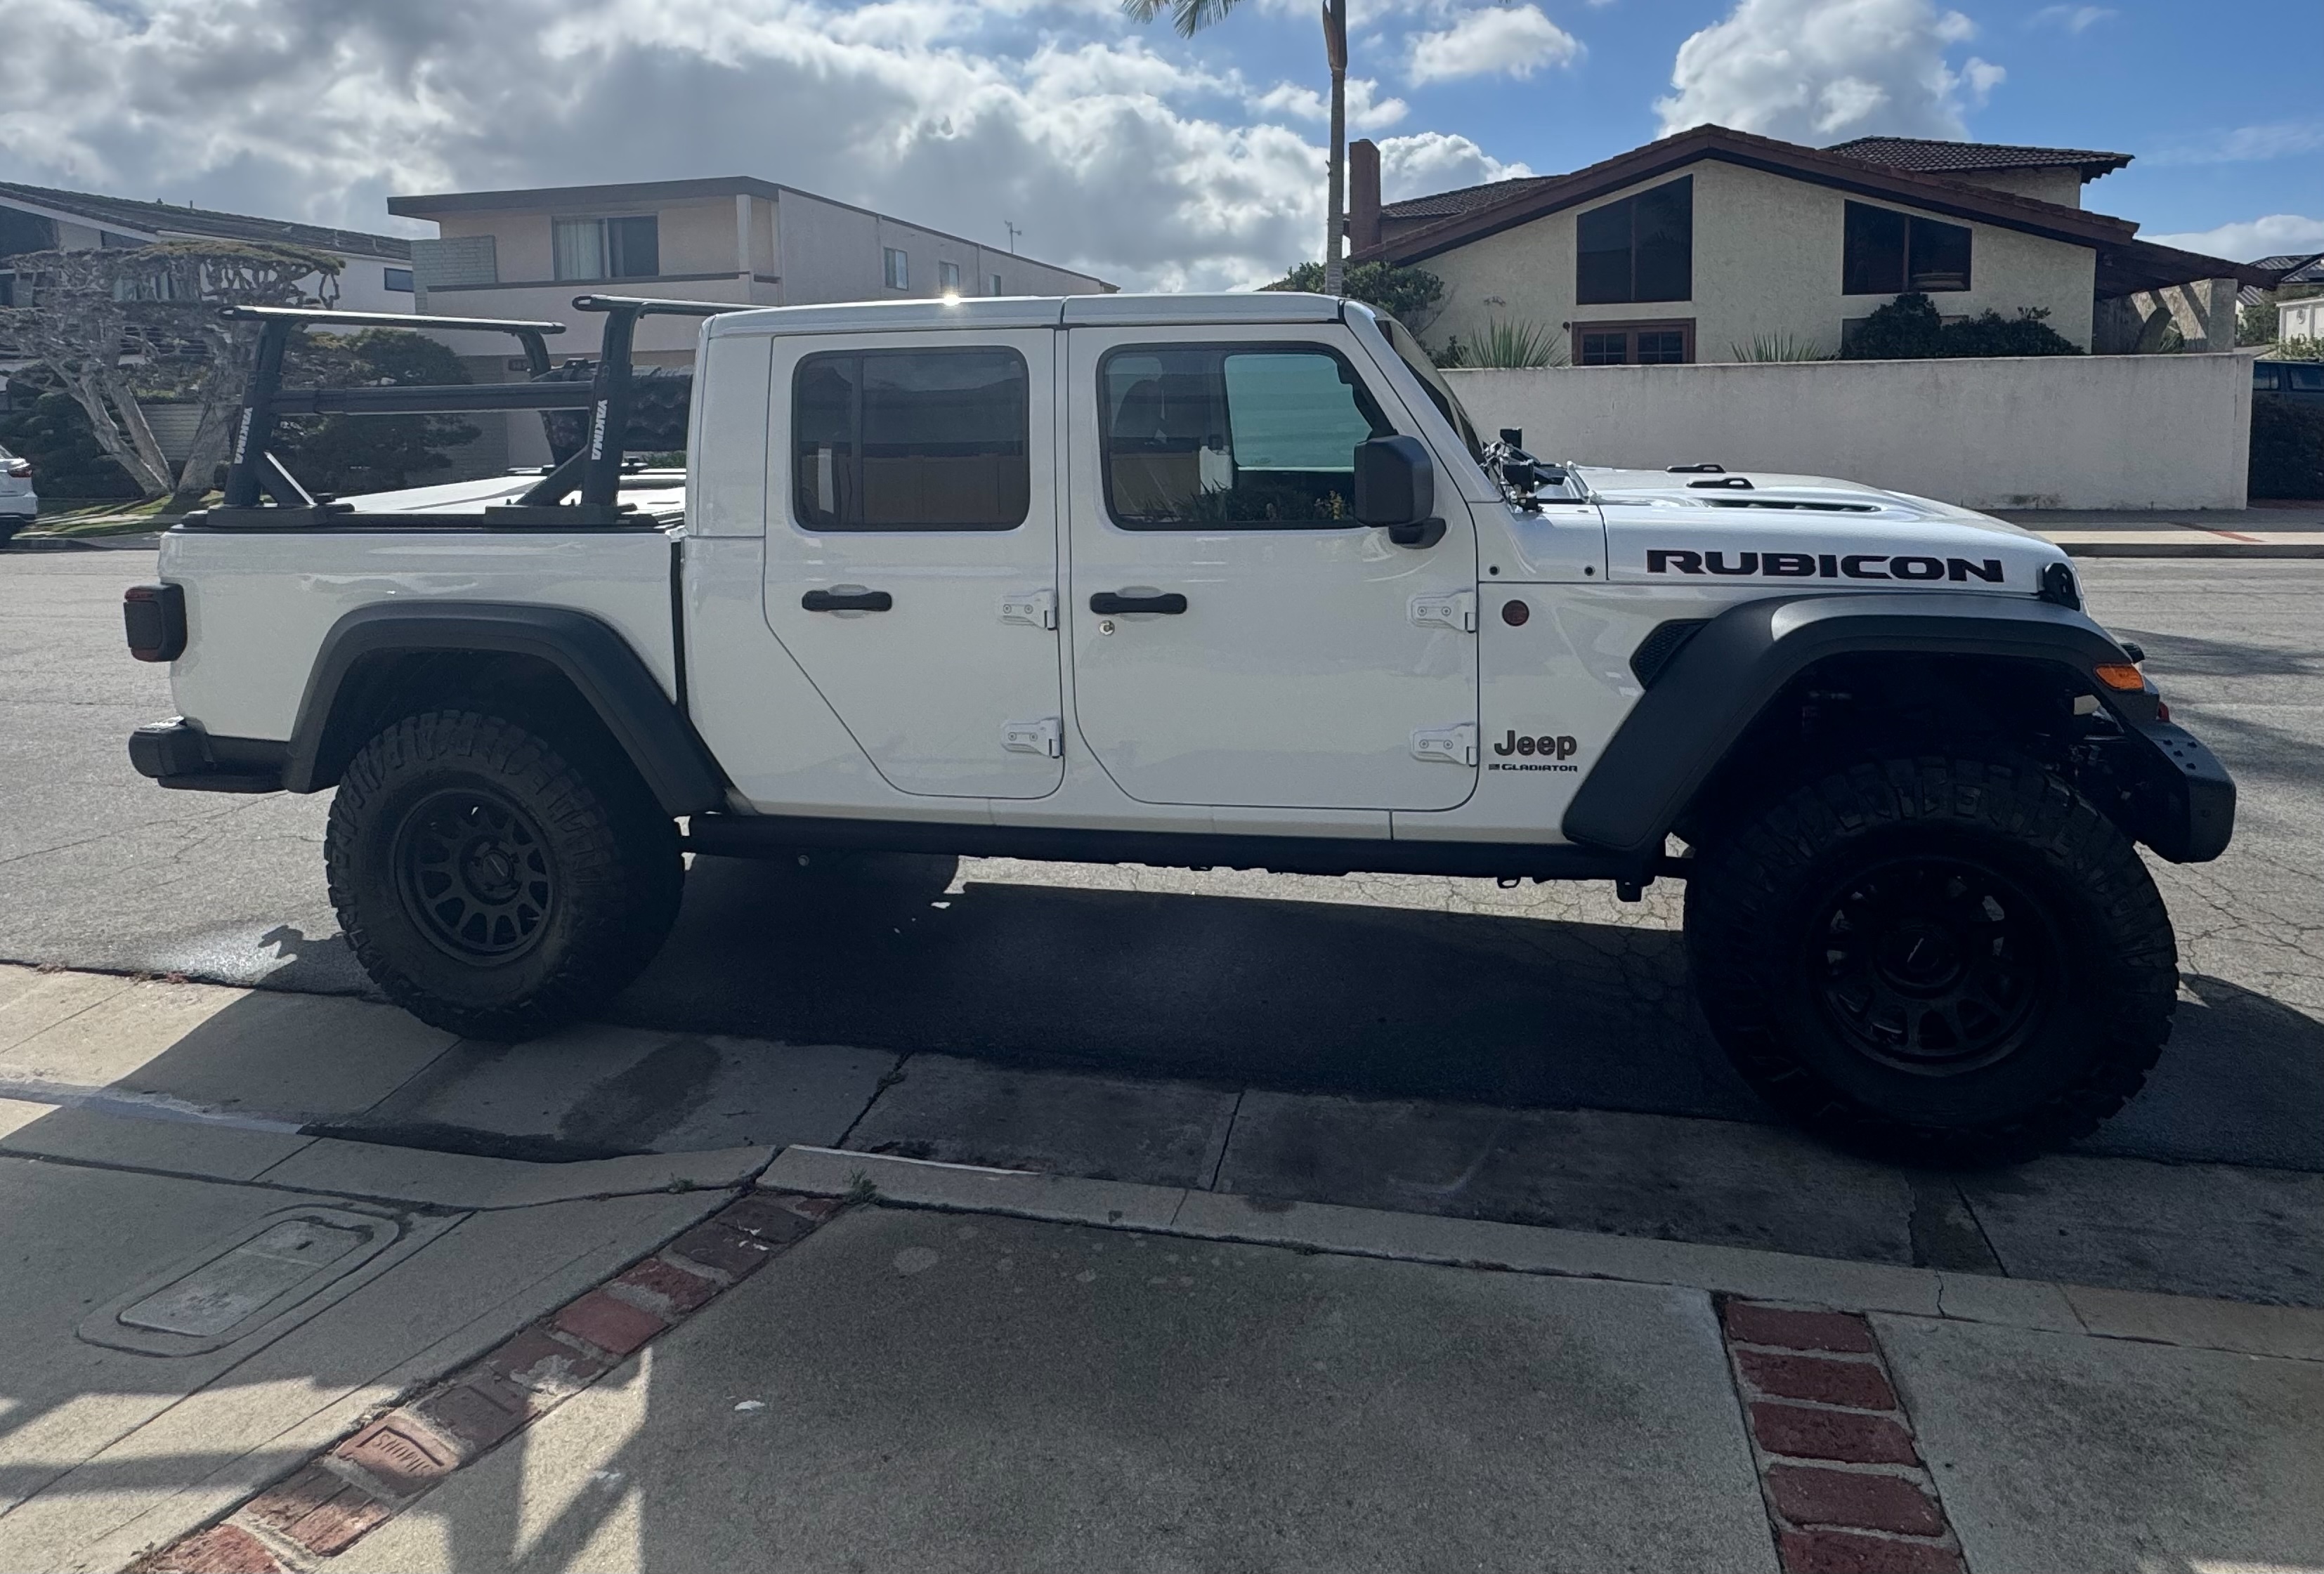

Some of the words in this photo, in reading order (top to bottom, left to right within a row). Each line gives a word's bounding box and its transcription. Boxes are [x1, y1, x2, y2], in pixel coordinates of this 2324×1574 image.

[234, 407, 252, 464] YAKIMA
[591, 400, 607, 459] YAKIMA
[1647, 549, 2004, 582] RUBICON
[1494, 730, 1577, 761] Jeep
[1501, 763, 1578, 773] GLADIATOR
